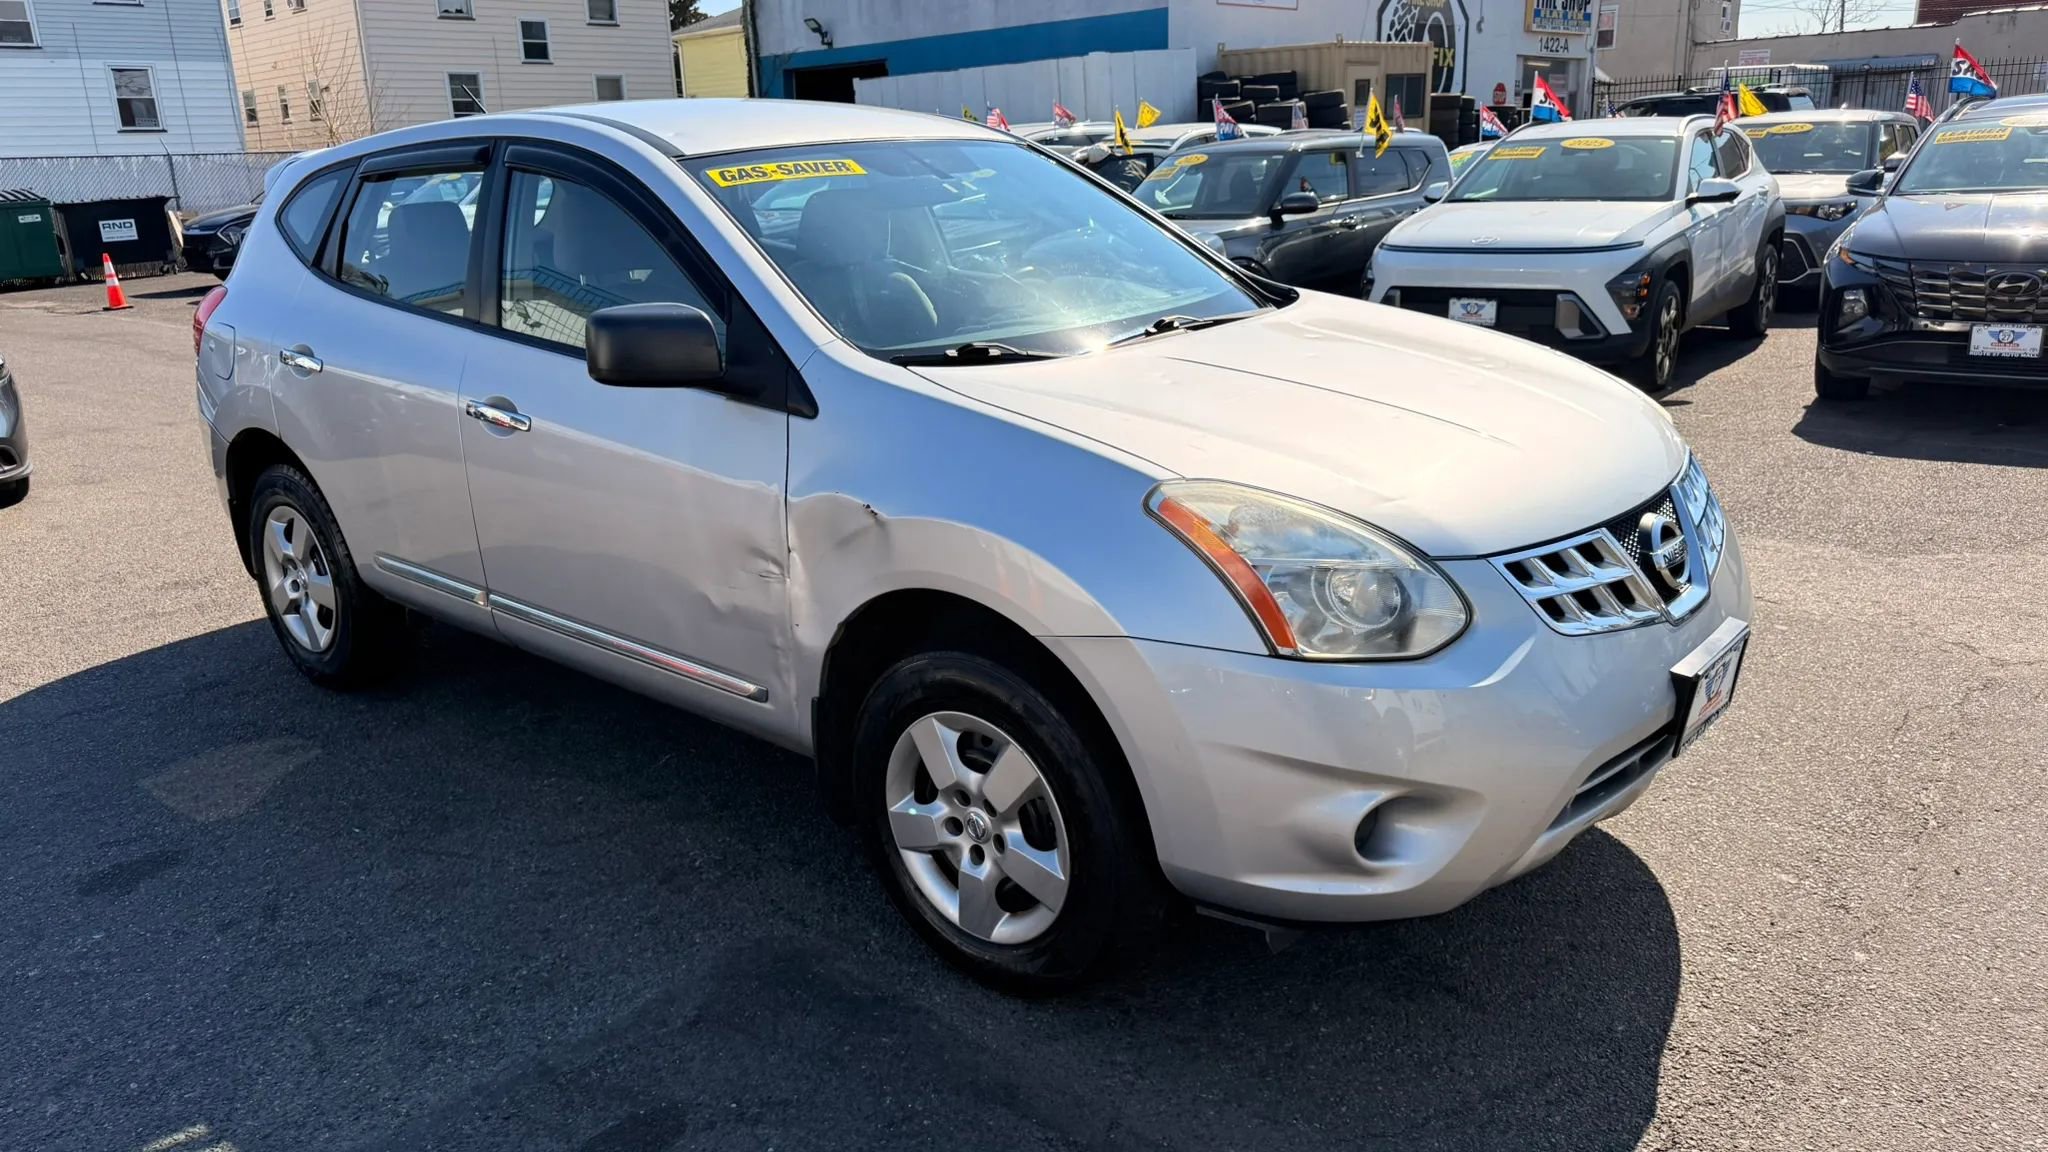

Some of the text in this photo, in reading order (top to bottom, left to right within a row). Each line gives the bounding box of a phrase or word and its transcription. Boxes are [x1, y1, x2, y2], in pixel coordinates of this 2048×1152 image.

[1561, 0, 1591, 12] SHOP
[1540, 9, 1584, 21] FLAT FIX
[1539, 37, 1569, 53] 1422-A
[1433, 48, 1455, 67] FIX
[718, 161, 851, 182] GAS-SAVER
[102, 221, 133, 230] RND
[2001, 333, 2011, 341] 27
